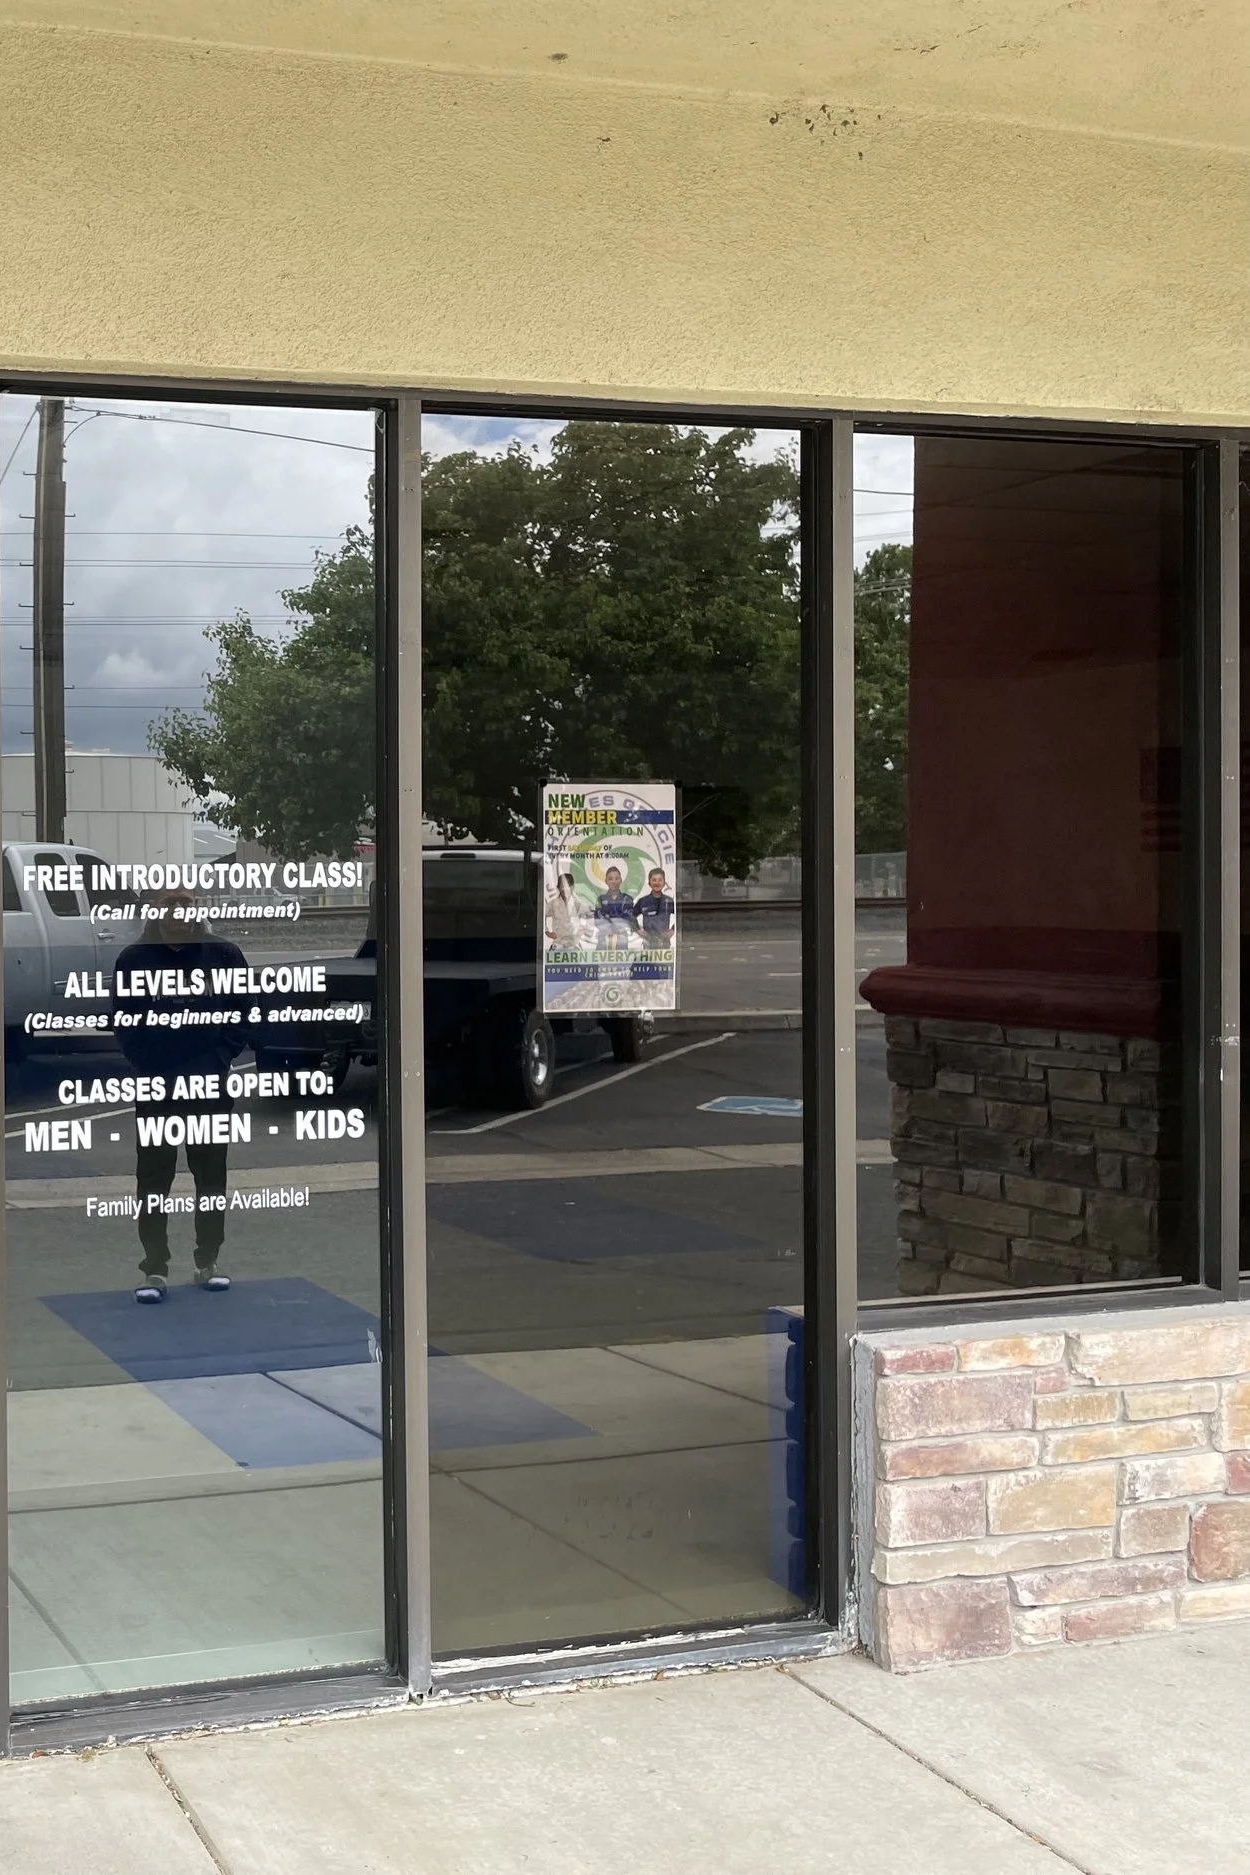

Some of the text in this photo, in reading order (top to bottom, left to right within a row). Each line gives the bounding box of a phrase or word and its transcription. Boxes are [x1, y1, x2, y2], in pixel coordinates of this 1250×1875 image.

[548, 793, 586, 809] NEW
[547, 826, 644, 836] ORIENTATION
[548, 810, 617, 824] MEMBER
[23, 862, 363, 891] FREE INTRODUCTORY CLASS!
[90, 902, 301, 925] (Call for appointment)
[546, 950, 672, 963] LEARN EVERYTHING
[64, 966, 327, 998] ALL LEVELS WELCOME
[24, 1013, 108, 1033] (Classes
[113, 1011, 142, 1028] for
[146, 1009, 241, 1029] beginners
[248, 1007, 262, 1023] &
[268, 1004, 364, 1025] advanced)
[58, 1071, 334, 1104] CLASSES ARE OPEN TO:
[25, 1120, 92, 1152] MEN
[137, 1113, 251, 1147] WOMEN
[295, 1108, 366, 1141] KIDS
[86, 1187, 310, 1220] Family Plans are Available!
